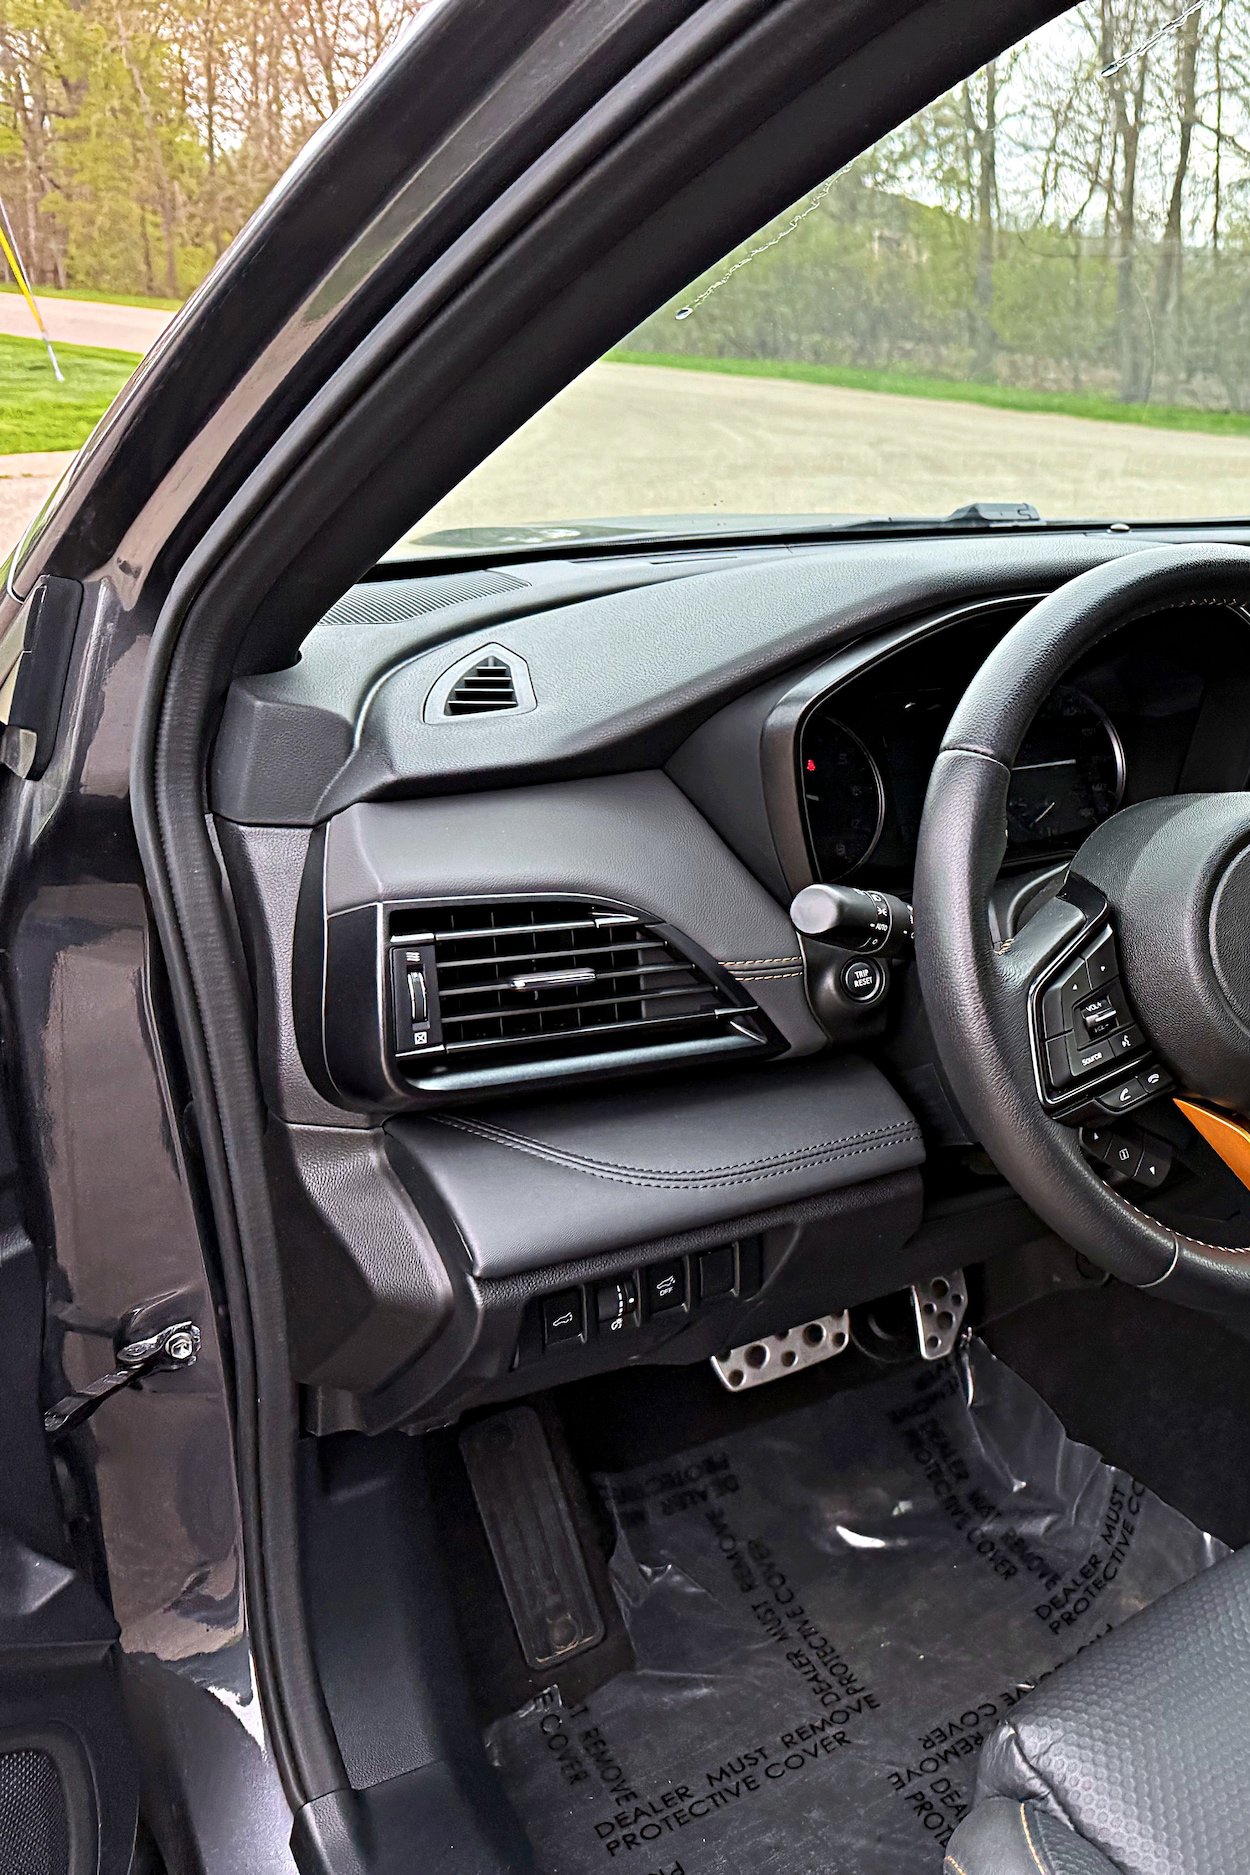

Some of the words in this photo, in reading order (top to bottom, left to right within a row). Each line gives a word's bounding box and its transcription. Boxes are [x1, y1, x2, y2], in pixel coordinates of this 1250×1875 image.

[875, 924, 888, 932] AUTO
[854, 969, 869, 979] TRIP
[854, 977, 873, 988] RESET
[1081, 1052, 1103, 1067] Source
[660, 1286, 674, 1297] OFF
[747, 1539, 795, 1607] COVER
[967, 1527, 1018, 1581] COVER
[1034, 1553, 1103, 1621] DEALER
[1101, 1484, 1126, 1545] MUST
[1050, 1521, 1137, 1634] PROTECTIVE
[752, 1601, 791, 1643] MUST
[786, 1604, 864, 1698] PROTECTIVE
[787, 1649, 841, 1707] DEALER
[540, 1713, 589, 1786] COVER
[918, 1703, 997, 1750] COVER
[580, 1727, 638, 1806] REMOVE
[594, 1785, 694, 1838] DEALER
[706, 1746, 769, 1789] MUST
[781, 1693, 880, 1748] REMOVE
[887, 1731, 984, 1791] REMOVE
[606, 1775, 761, 1857] PROTECTIVE
[765, 1731, 851, 1782] COVER
